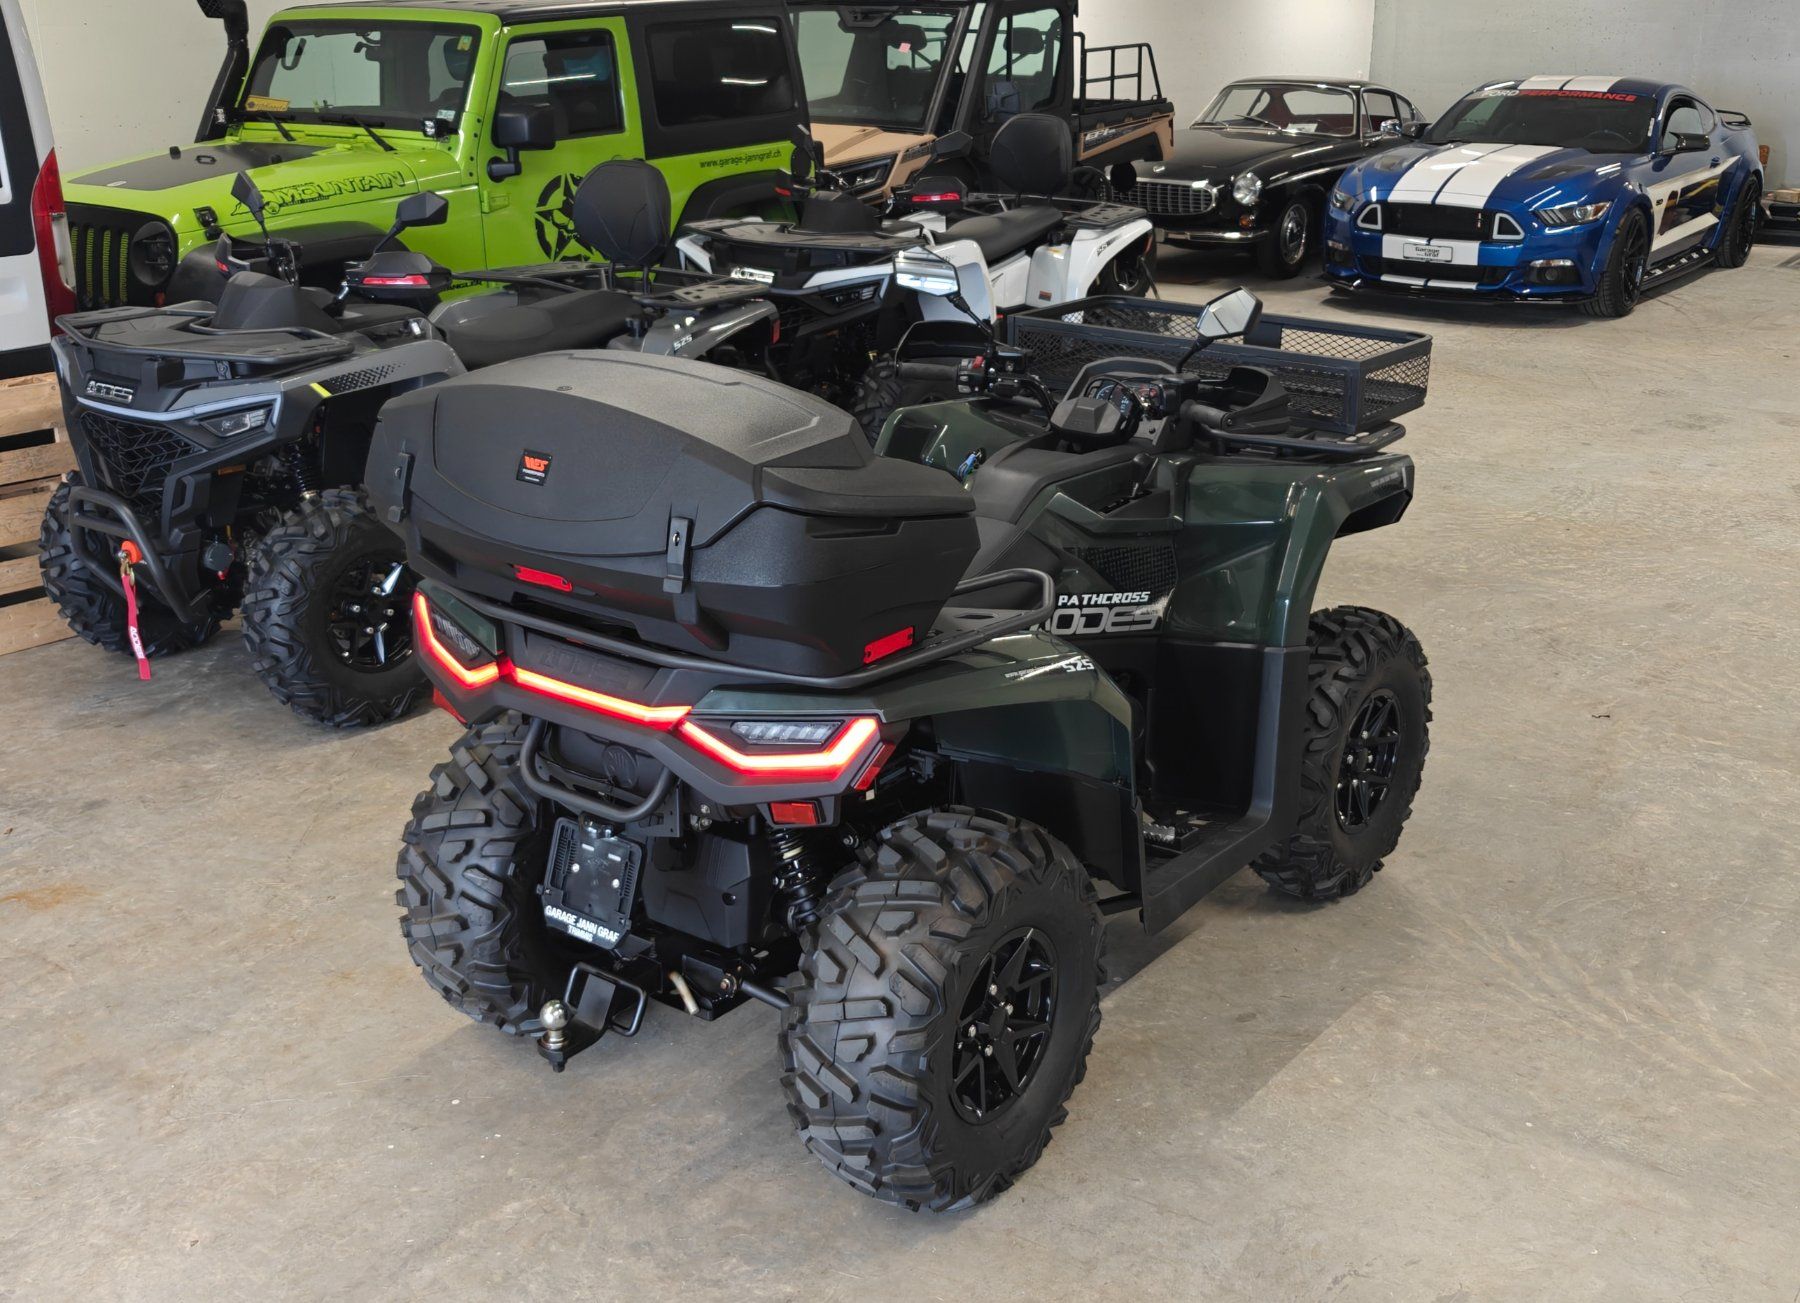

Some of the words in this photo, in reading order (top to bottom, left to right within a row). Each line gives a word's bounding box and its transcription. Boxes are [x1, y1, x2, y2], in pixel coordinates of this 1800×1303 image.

[1519, 90, 1637, 102] PERFORMANCE
[673, 334, 693, 351] 525
[1058, 591, 1151, 606] PATHCROSS
[1050, 605, 1160, 635] ODES
[1062, 657, 1095, 672] 525
[545, 905, 577, 926] GARAGE
[576, 917, 598, 935] JANN
[597, 925, 620, 943] GRAF
